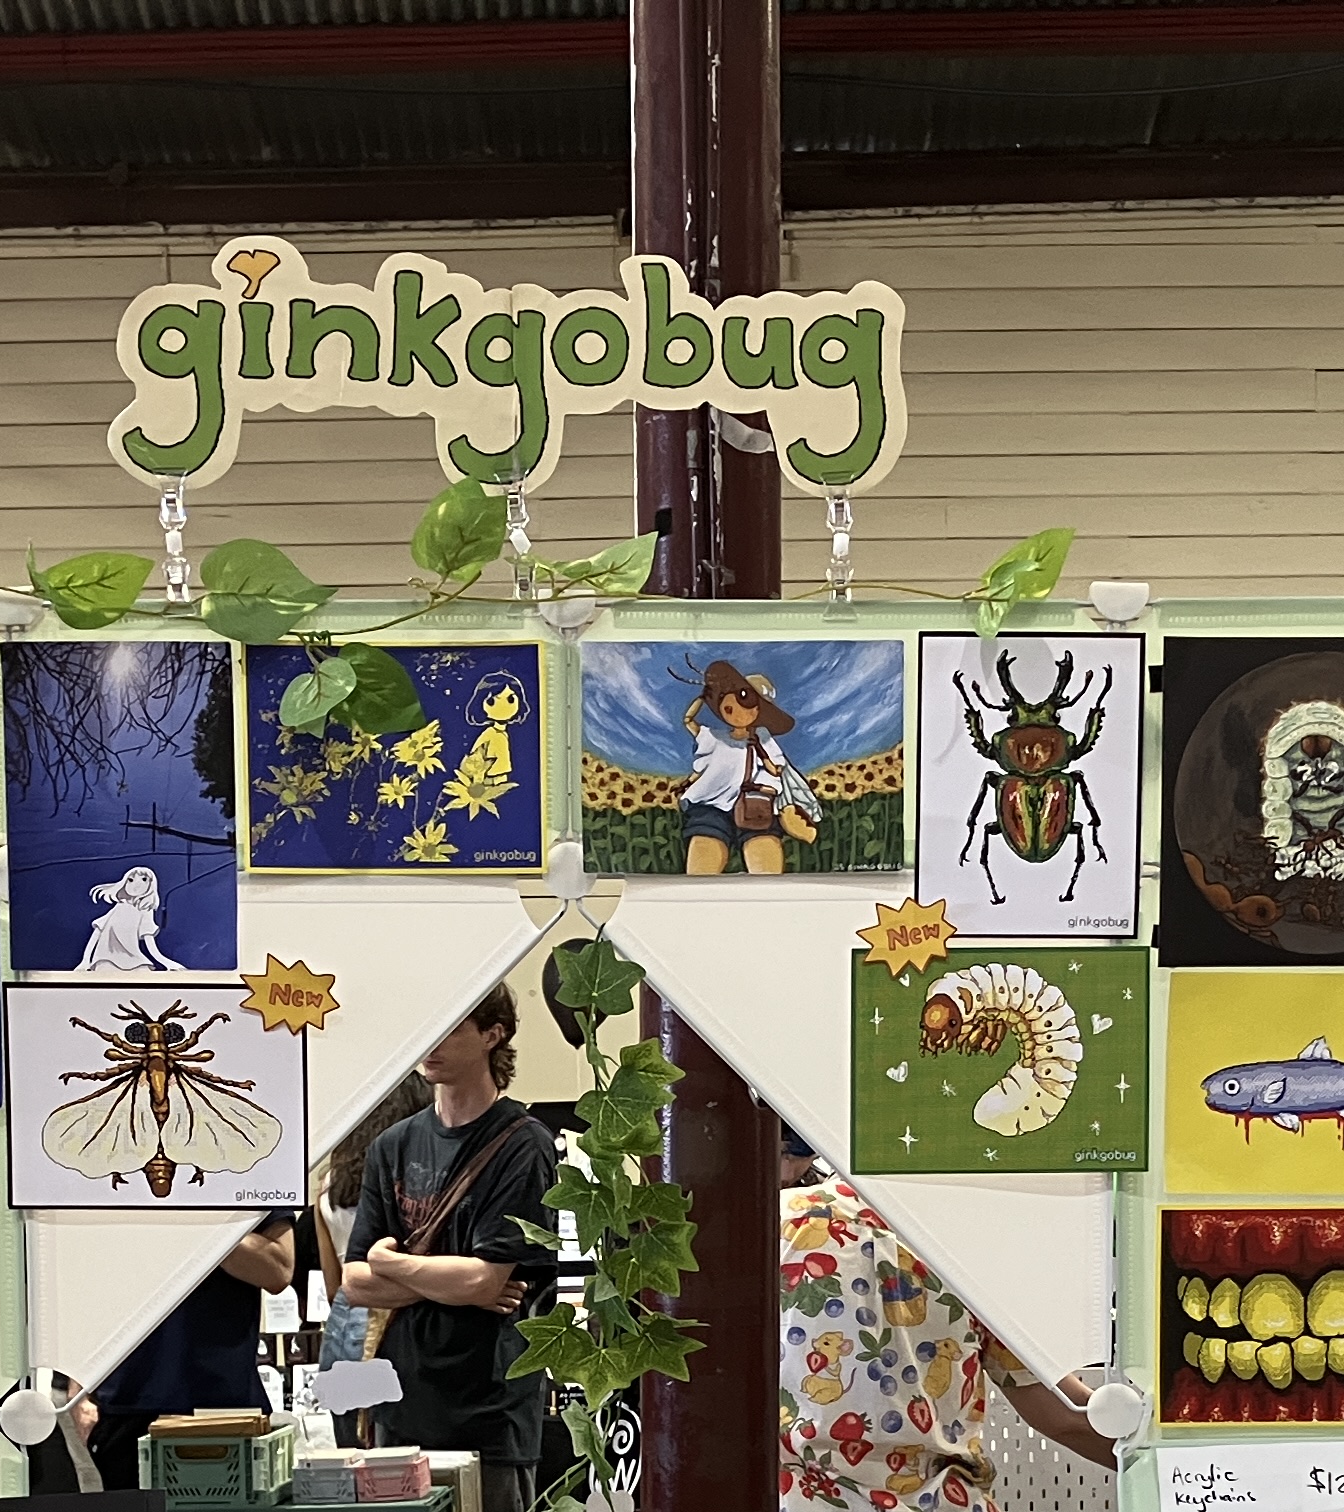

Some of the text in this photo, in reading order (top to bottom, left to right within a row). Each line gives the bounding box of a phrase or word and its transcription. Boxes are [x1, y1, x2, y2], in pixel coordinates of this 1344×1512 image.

[122, 252, 884, 486] ginkgobug
[474, 848, 537, 863] ginkgobug
[1067, 915, 1130, 930] ginkgobug
[886, 922, 941, 950] New
[268, 983, 323, 1009] New
[1074, 1148, 1137, 1163] ginkgobug
[235, 1187, 297, 1202] ginkgobug
[1172, 1464, 1239, 1489] Acrylic
